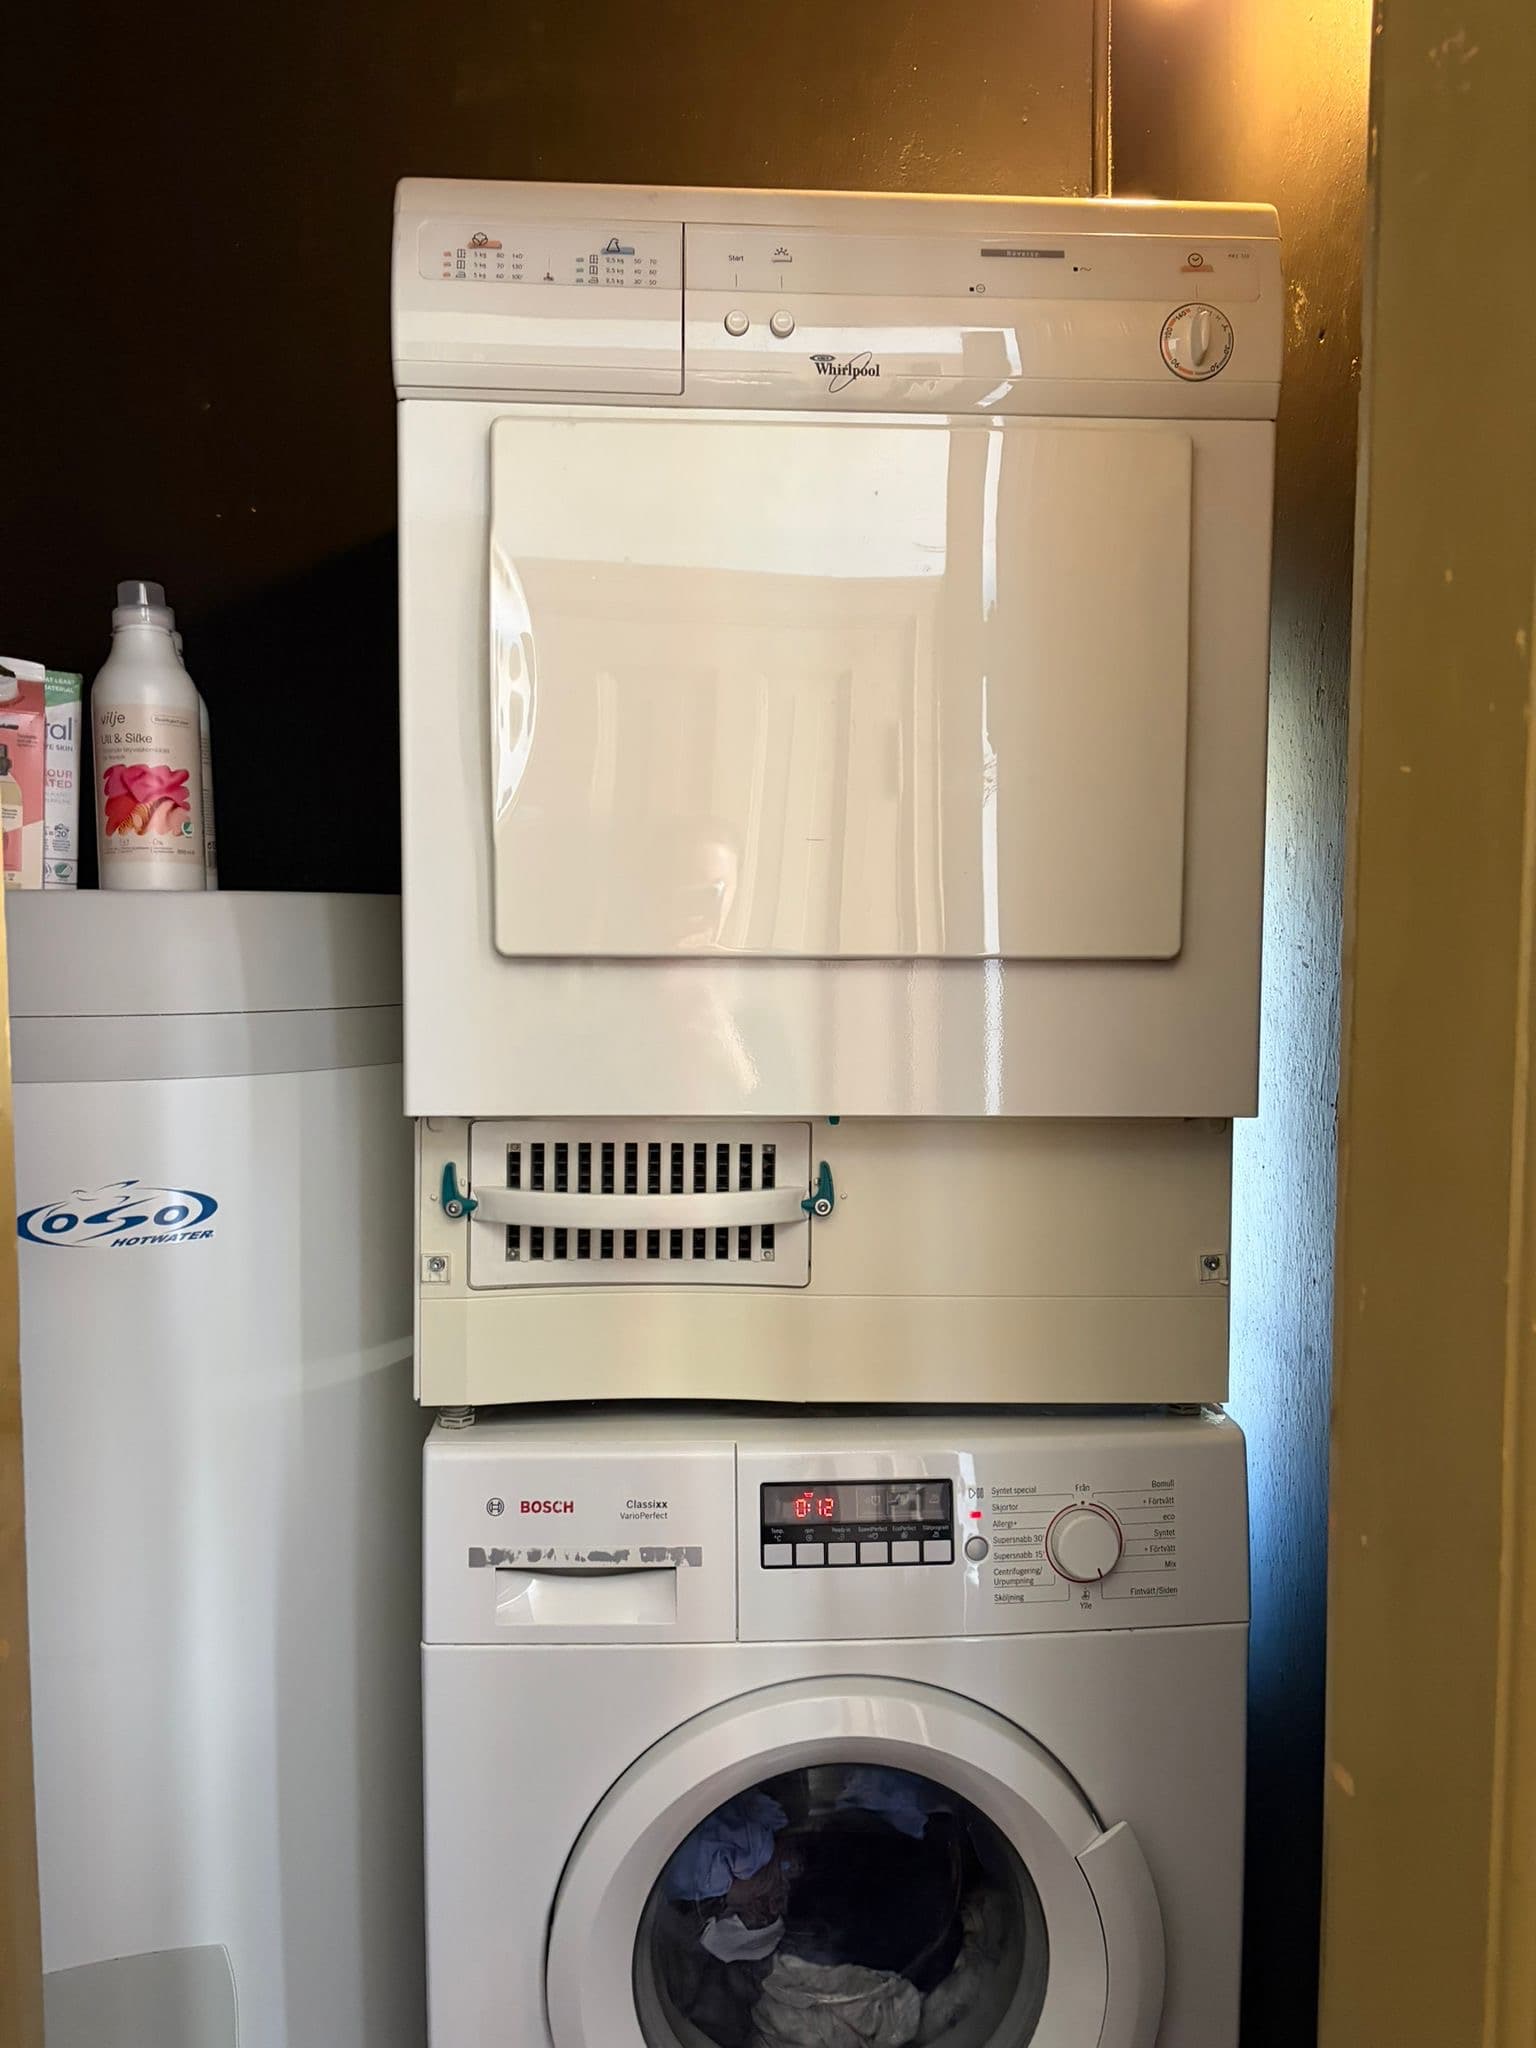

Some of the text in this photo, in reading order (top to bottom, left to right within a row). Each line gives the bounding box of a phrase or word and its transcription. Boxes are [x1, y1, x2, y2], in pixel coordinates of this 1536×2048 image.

[813, 362, 880, 380] Whirlpool
[101, 711, 126, 728] vilje
[114, 734, 122, 744] &
[125, 732, 152, 744] Silke
[56, 744, 73, 752] SKIN
[41, 1198, 189, 1241] OSO
[110, 1230, 213, 1248] HOTWATER
[1075, 1484, 1090, 1492] Från
[1151, 1480, 1175, 1488] Bomull
[991, 1486, 1037, 1496] Syntet special
[626, 1499, 668, 1510] Classixx
[1148, 1497, 1175, 1505] Förtvätt
[520, 1501, 574, 1514] BOSCH
[794, 1498, 834, 1517] 0:12
[991, 1503, 1018, 1512] Skjortor
[620, 1511, 668, 1521] VarioPerfect
[1153, 1528, 1176, 1537] Syntet
[992, 1535, 1033, 1545] Supersnabb
[1149, 1545, 1176, 1553] Förtvätt
[993, 1551, 1033, 1561] Supersnabb
[1164, 1560, 1177, 1568] Mix
[993, 1567, 1043, 1577] Centrifugering/
[1130, 1586, 1178, 1596] Fintvätt/Siden
[994, 1593, 1025, 1602] Sköljning
[1079, 1602, 1092, 1610] Ylle
